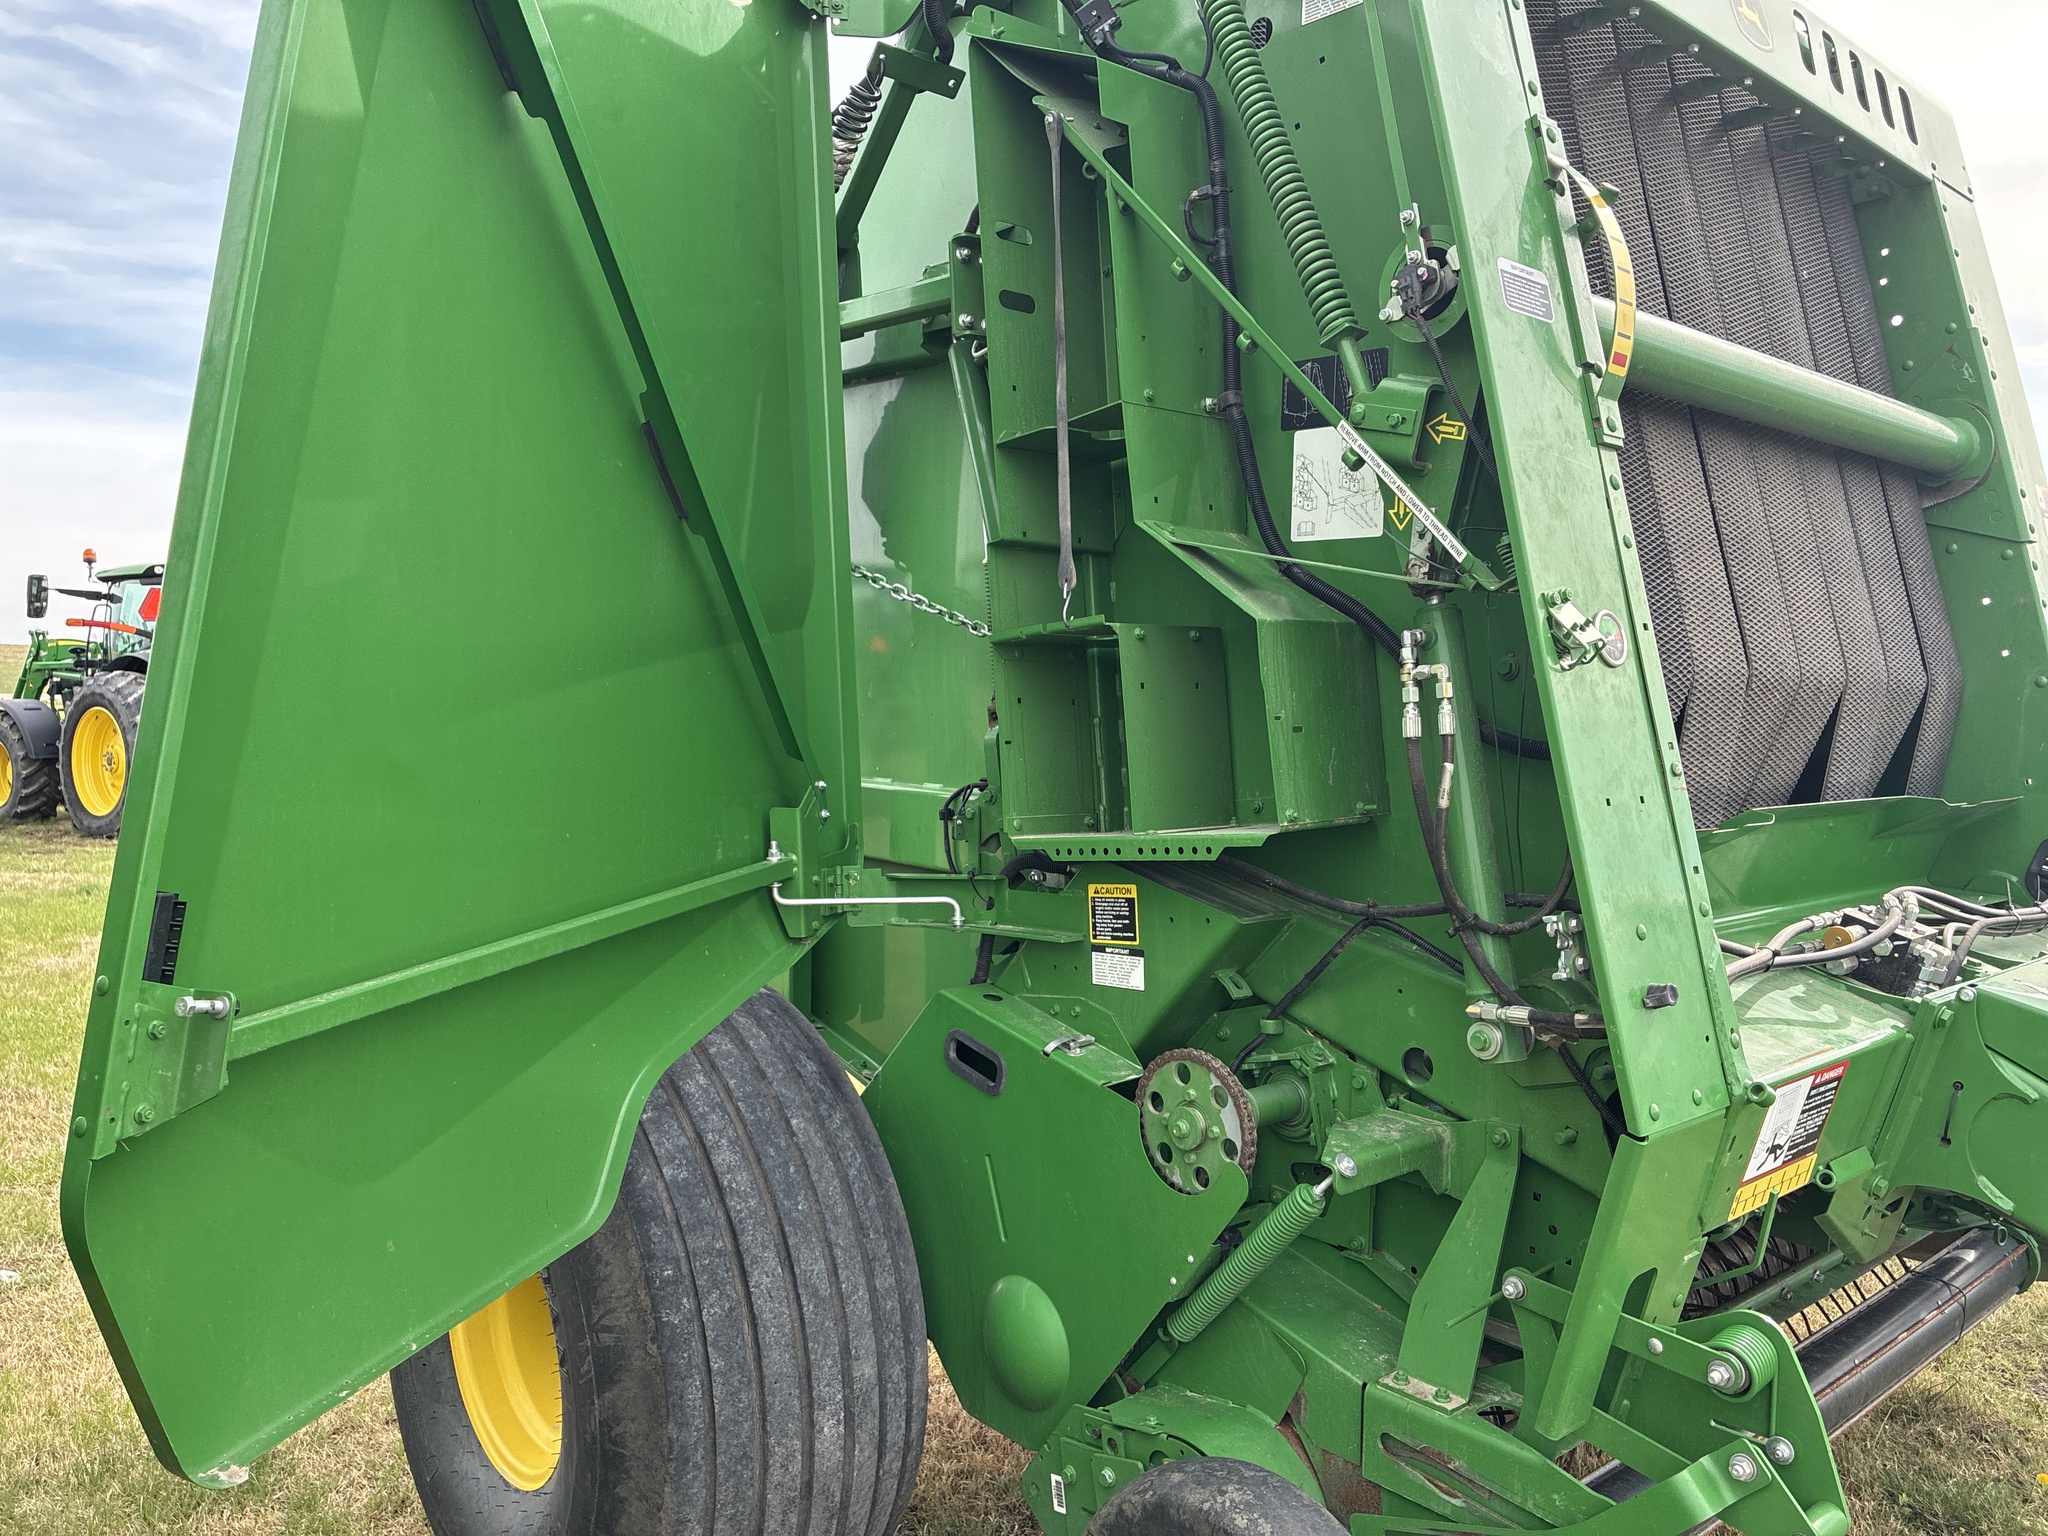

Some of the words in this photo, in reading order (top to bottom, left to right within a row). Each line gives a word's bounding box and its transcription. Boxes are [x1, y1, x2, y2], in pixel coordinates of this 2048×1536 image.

[1339, 423, 1359, 443] REMOVE
[1357, 441, 1369, 457] ARM
[1367, 453, 1382, 471] FROM
[1380, 468, 1397, 488] NOTCH
[1395, 484, 1406, 497] AND
[1405, 494, 1424, 515] LOWER
[1422, 511, 1430, 522] TO
[1429, 519, 1448, 542] THREAD
[1447, 538, 1464, 559] TWINE
[1100, 887, 1132, 895] CAUTION
[1821, 1066, 1844, 1081] DANGER
